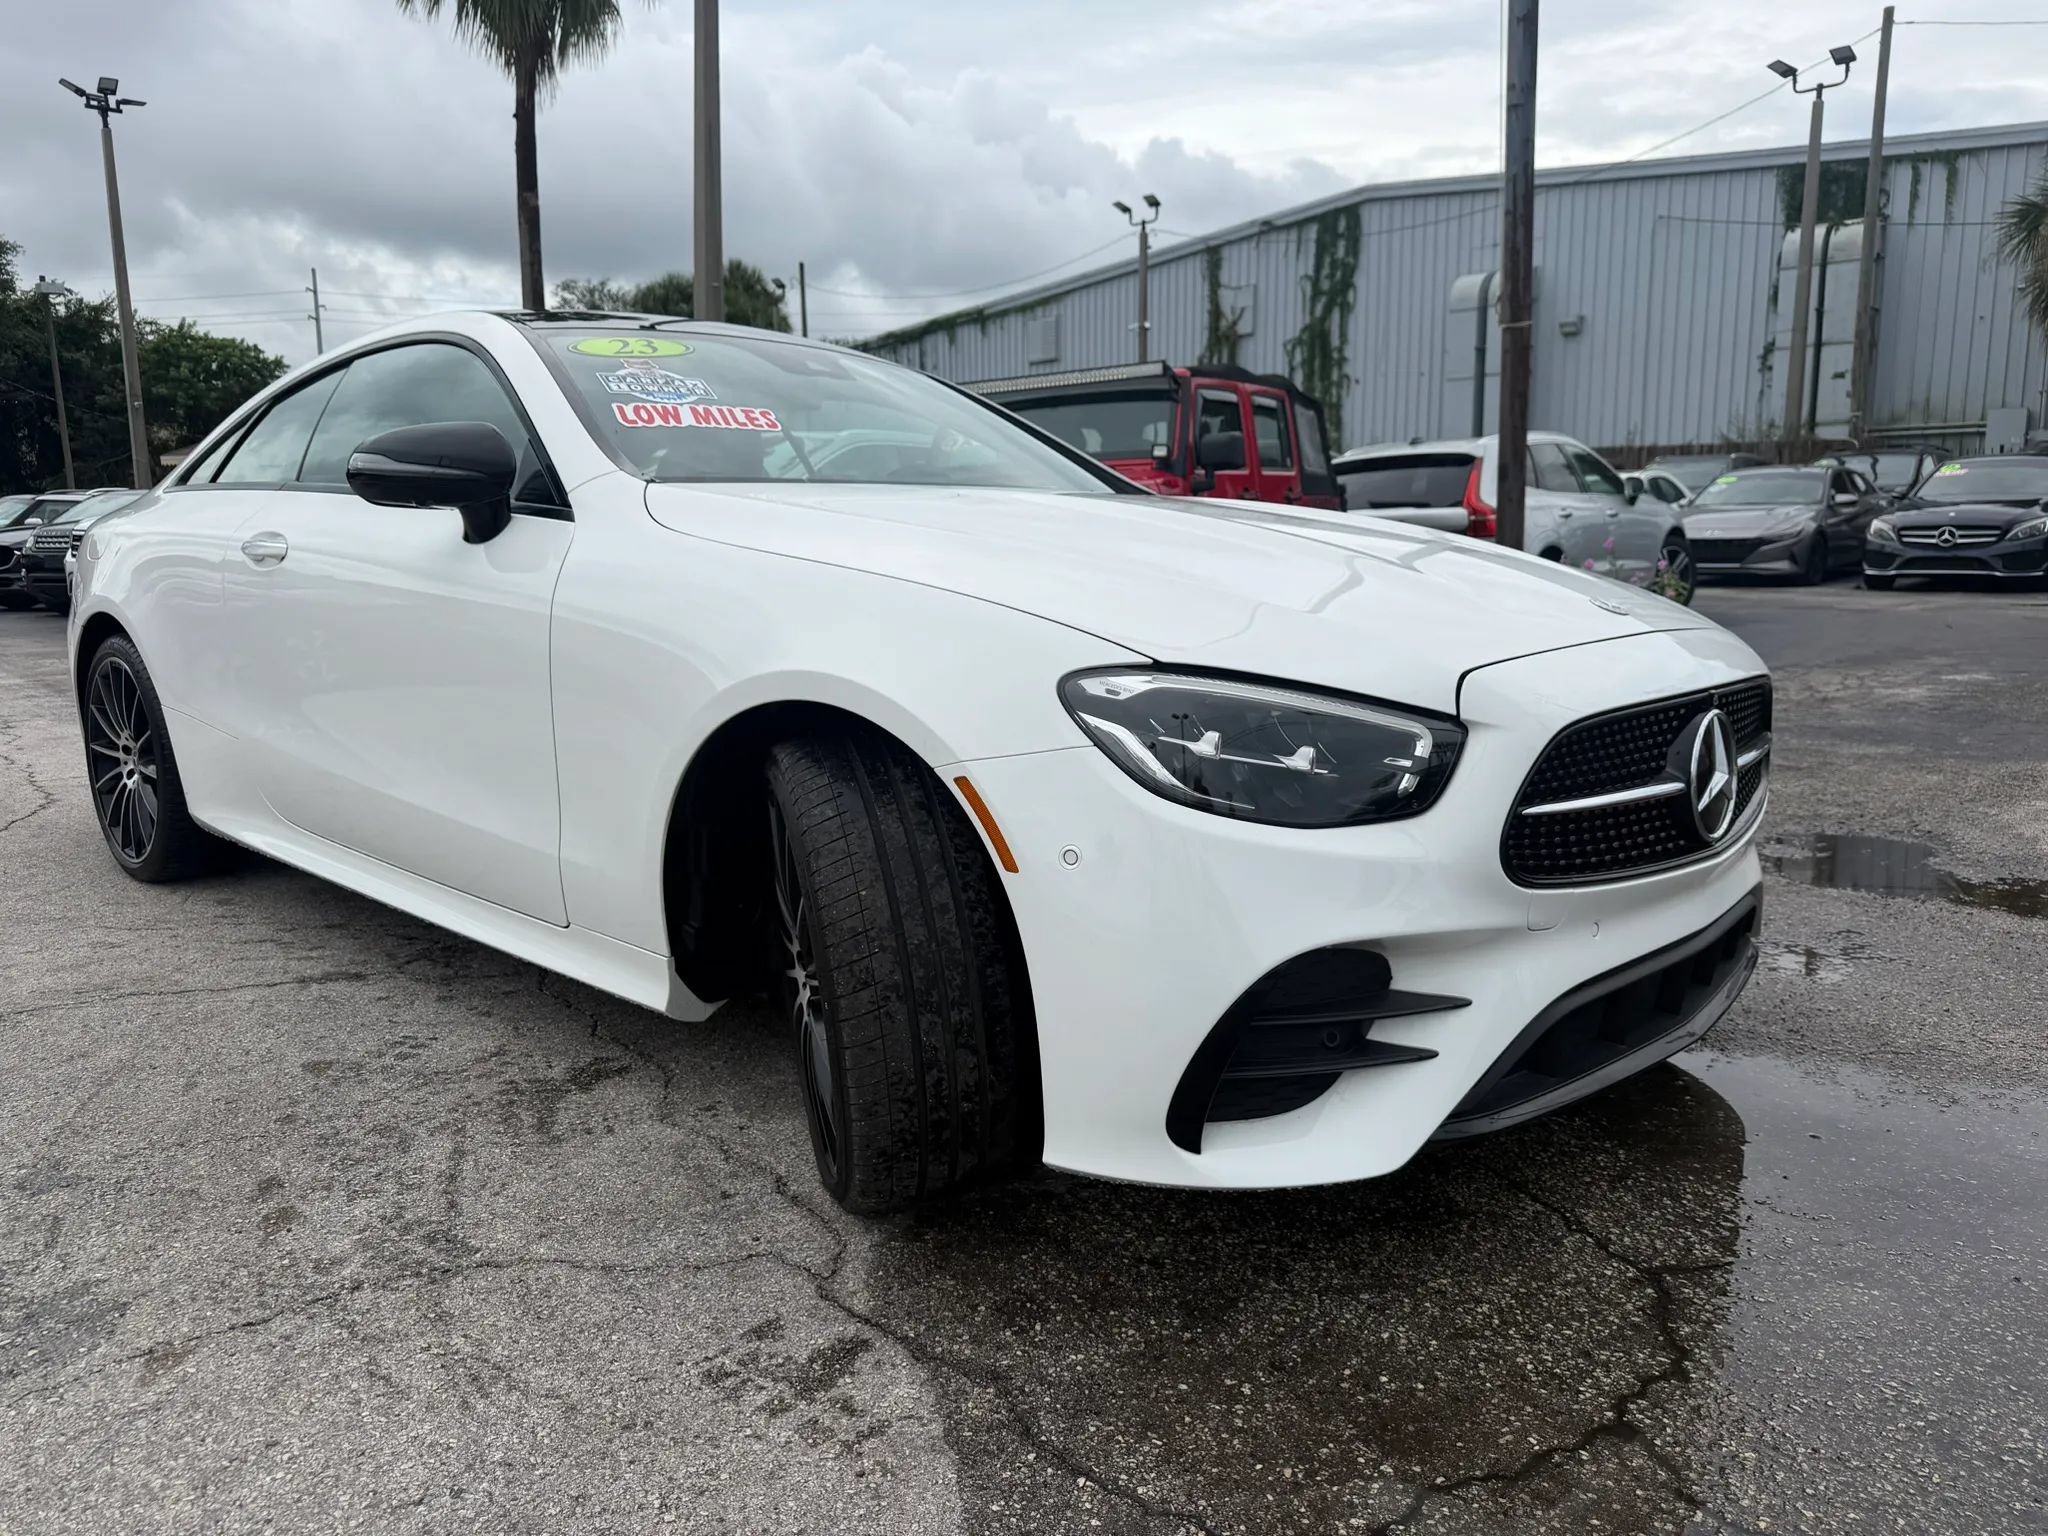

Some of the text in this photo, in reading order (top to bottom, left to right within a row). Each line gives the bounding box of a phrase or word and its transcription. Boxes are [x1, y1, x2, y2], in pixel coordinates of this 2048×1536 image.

[607, 339, 658, 354] 23
[629, 384, 707, 396] OWNER
[616, 404, 780, 430] LOW MILES
